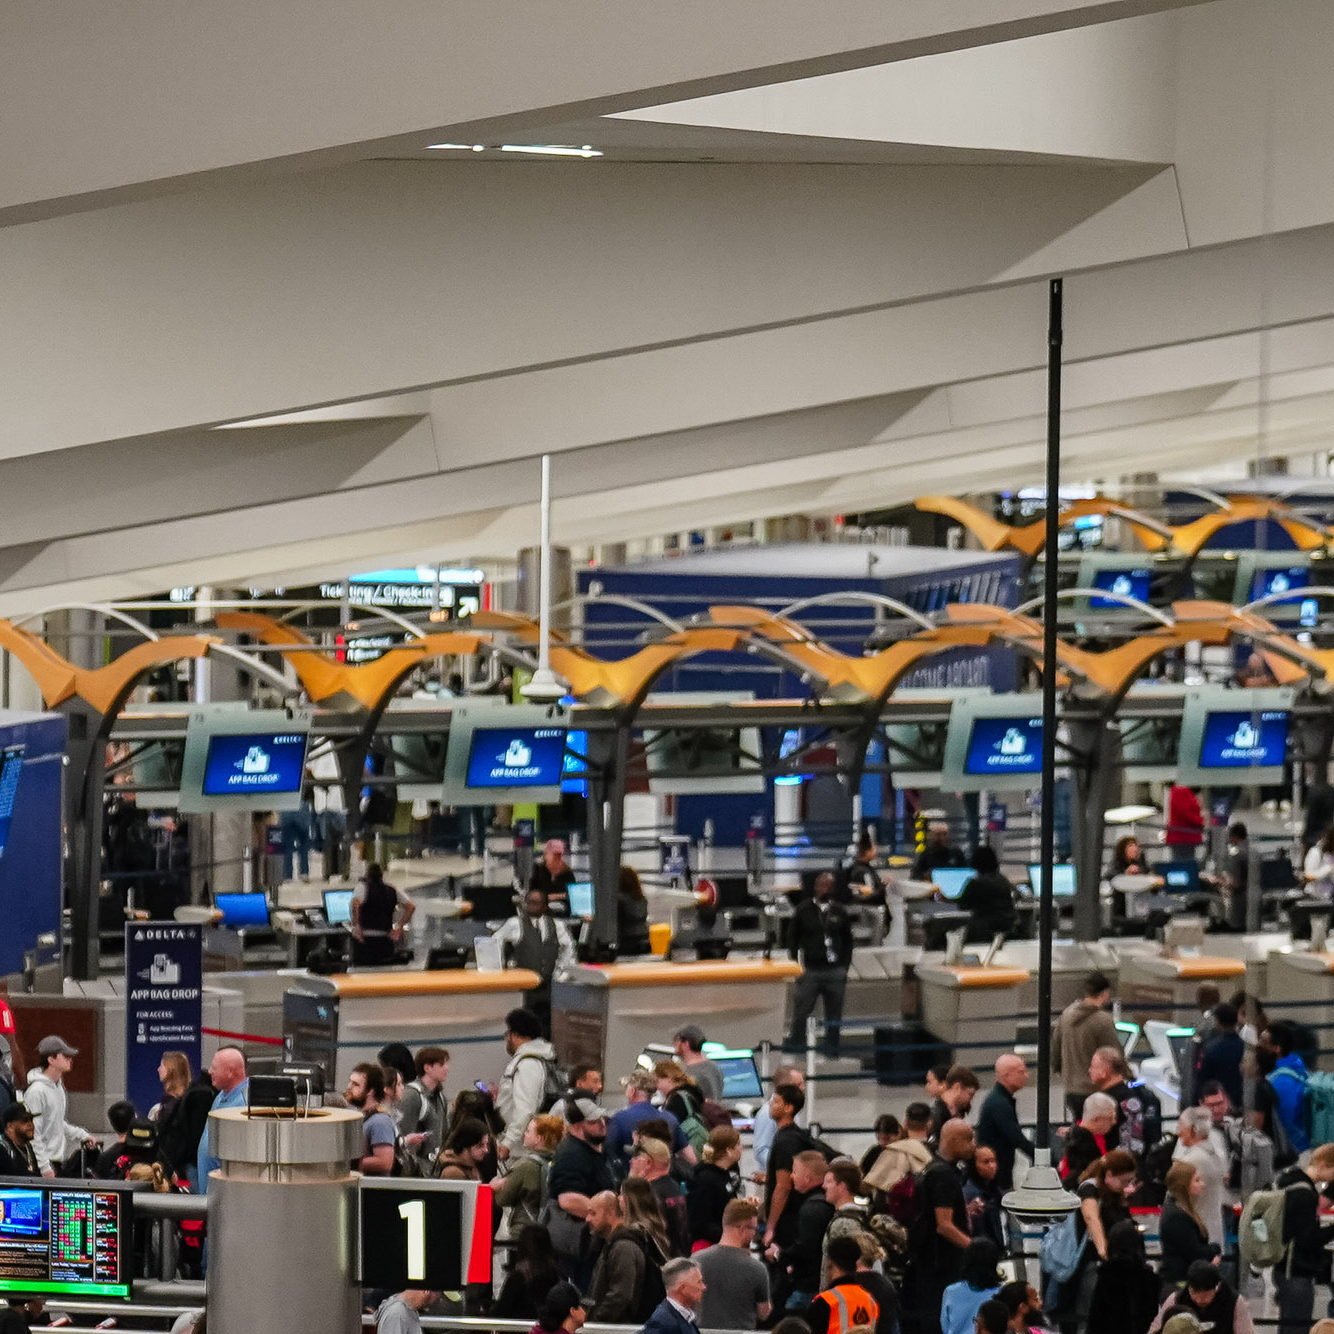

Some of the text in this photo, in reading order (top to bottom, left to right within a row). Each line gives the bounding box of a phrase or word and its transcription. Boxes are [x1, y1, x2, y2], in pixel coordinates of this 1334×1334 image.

[146, 930, 184, 939] DELTA
[131, 989, 198, 1000] APP BAG DROP
[398, 1200, 425, 1280] 1
